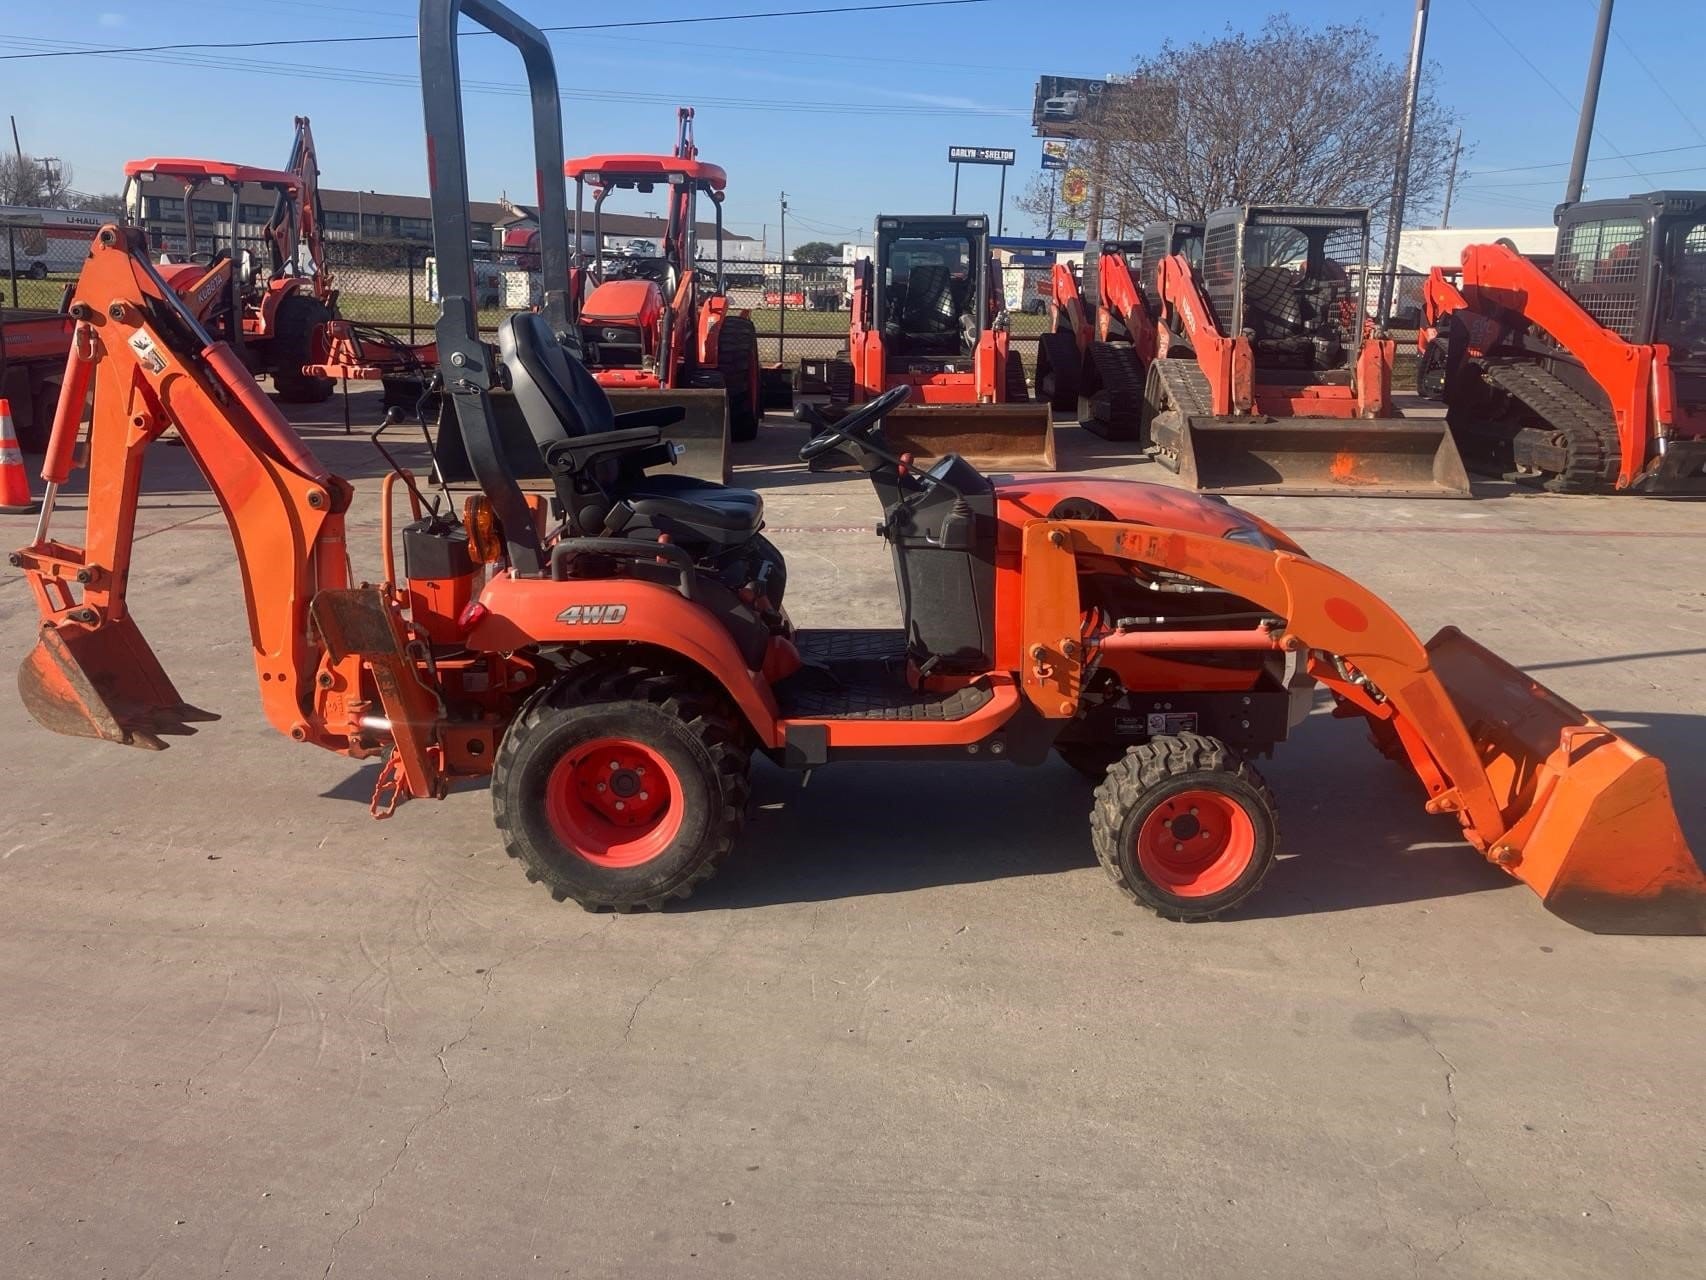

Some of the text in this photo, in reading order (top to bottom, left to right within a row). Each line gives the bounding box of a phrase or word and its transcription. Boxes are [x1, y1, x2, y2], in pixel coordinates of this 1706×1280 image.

[984, 150, 1014, 160] SHELTON
[66, 216, 101, 225] U-HAUL
[197, 274, 224, 303] KUBOTA
[556, 604, 627, 625] 4WD
